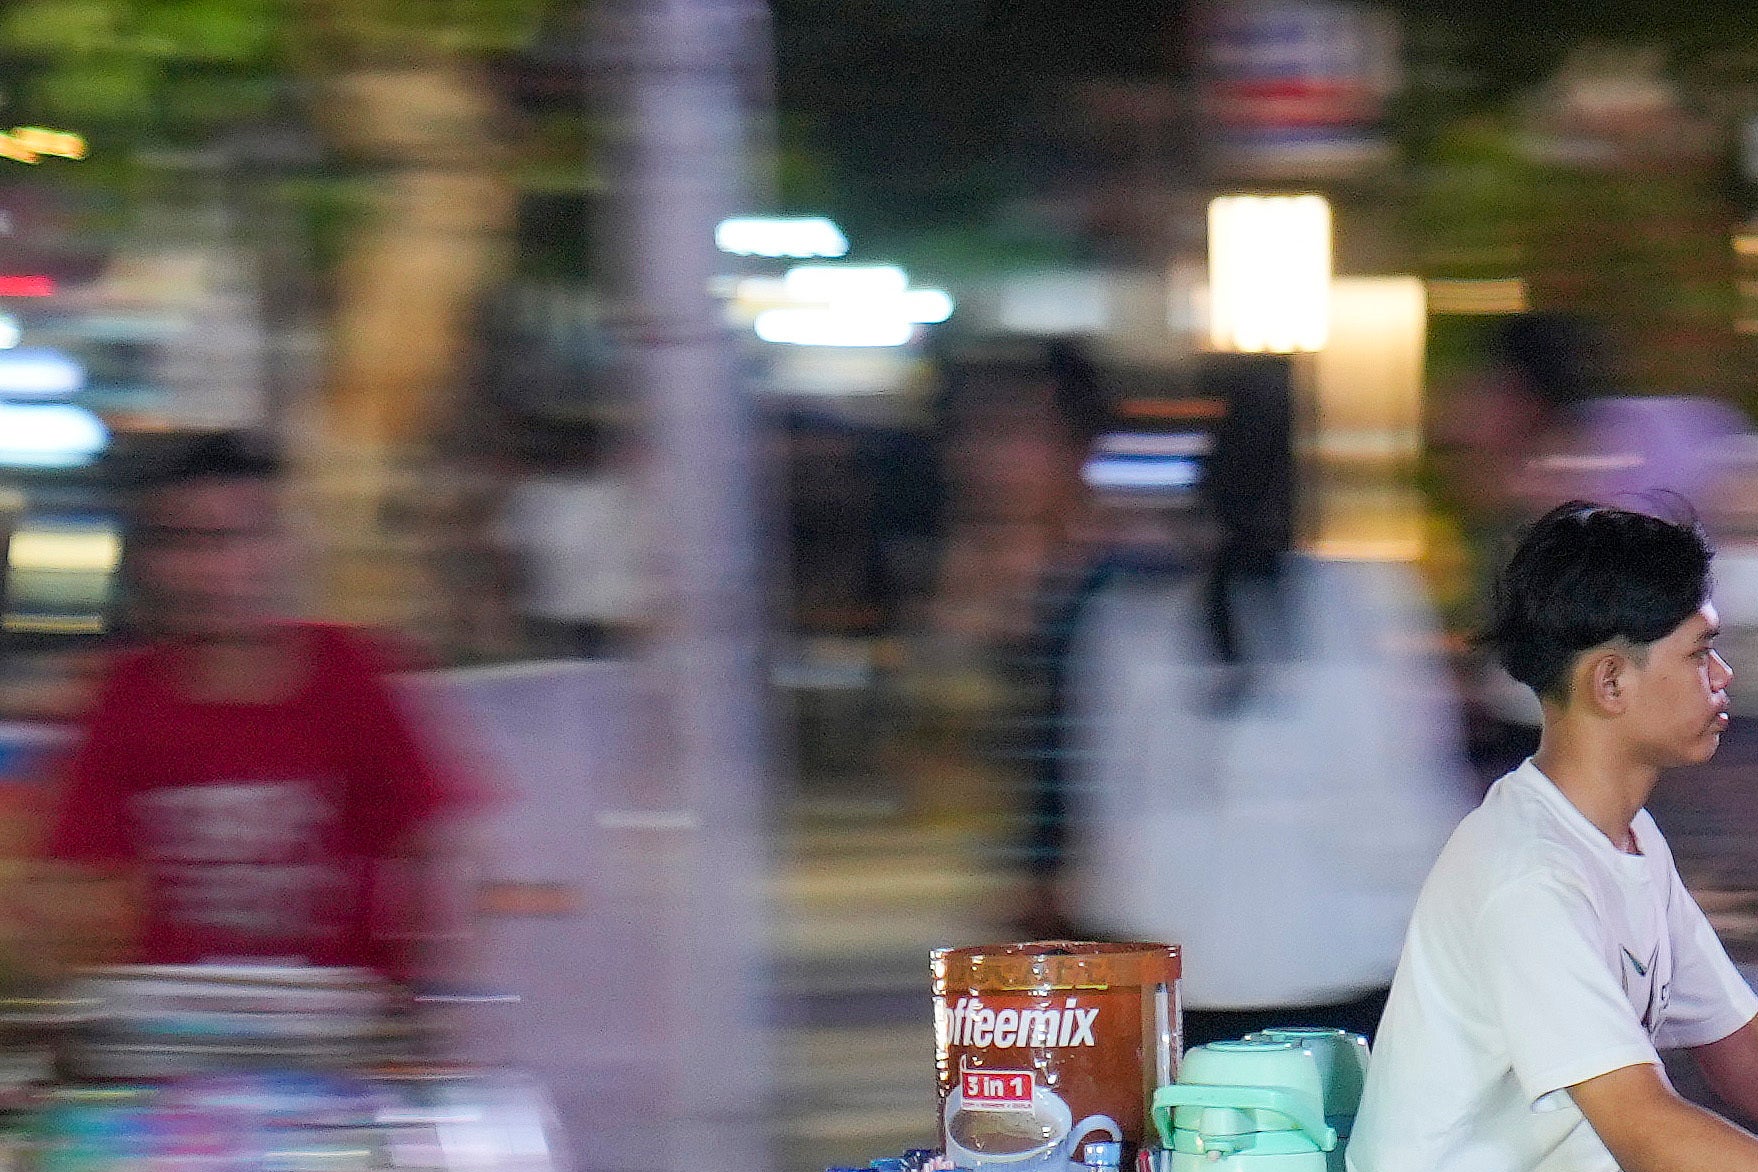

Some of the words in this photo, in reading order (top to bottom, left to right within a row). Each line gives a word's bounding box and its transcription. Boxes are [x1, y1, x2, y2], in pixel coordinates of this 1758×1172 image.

[967, 1075, 979, 1097] 3
[983, 1075, 1004, 1097] in
[1009, 1076, 1023, 1097] 1
